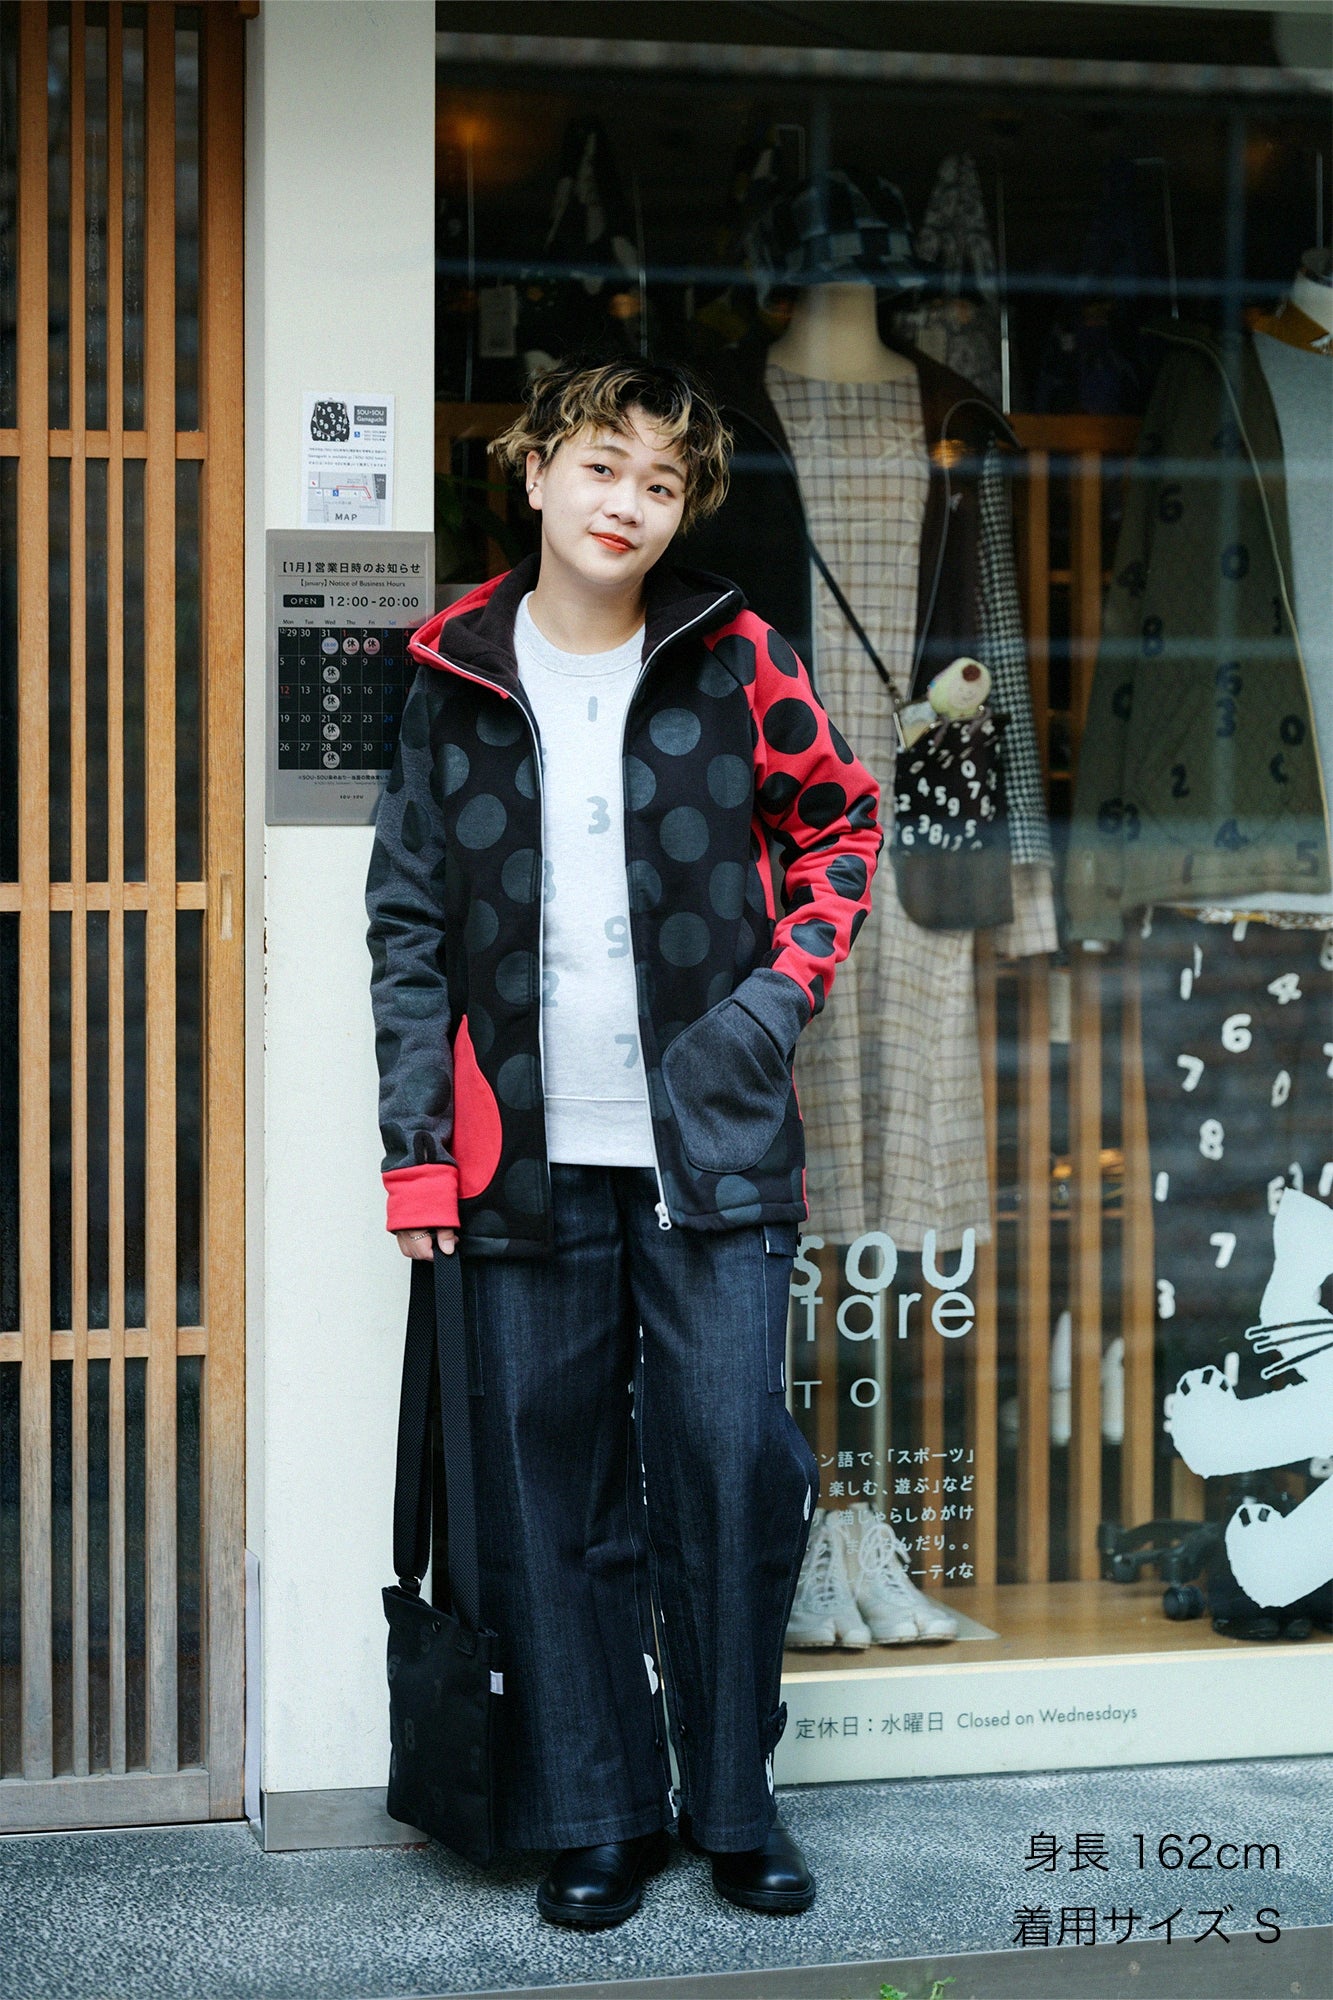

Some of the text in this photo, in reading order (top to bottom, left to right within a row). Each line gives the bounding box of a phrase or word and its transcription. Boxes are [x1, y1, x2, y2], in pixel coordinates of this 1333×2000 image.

[1159, 484, 1184, 525] 6
[334, 513, 358, 521] MAP
[387, 580, 406, 588] Hours
[290, 597, 317, 606] OPEN
[287, 629, 297, 638] 29
[300, 629, 311, 638] 30
[321, 629, 331, 638] 31
[362, 629, 368, 638] 2
[347, 639, 377, 648] 休 休
[1142, 613, 1165, 657] 8
[280, 657, 285, 666] 5
[300, 657, 306, 666] 6
[321, 657, 326, 666] 7
[341, 657, 348, 666] 8
[362, 657, 368, 666] 9
[384, 657, 394, 666] 10
[326, 667, 336, 676] 休
[280, 686, 290, 695] 12
[301, 686, 311, 695] 13
[321, 686, 331, 695] 14
[342, 686, 352, 695] 15
[363, 686, 373, 695] 16
[327, 695, 336, 705] 休
[280, 714, 290, 723] 19
[300, 714, 311, 723] 20
[321, 714, 331, 723] 21
[341, 714, 352, 723] 22
[362, 714, 373, 723] 23
[327, 724, 336, 733] 休
[1279, 713, 1306, 747] 0
[280, 743, 290, 752] 26
[300, 743, 311, 752] 27
[321, 743, 331, 752] 28
[342, 743, 352, 752] 29
[362, 743, 373, 752] 30
[327, 752, 336, 762] 休
[960, 759, 977, 779] 0
[967, 781, 982, 800] 7
[1170, 762, 1191, 799] 2
[899, 793, 912, 812] 2
[934, 785, 948, 806] 5
[586, 795, 611, 834] 3
[947, 797, 960, 817] 9
[917, 814, 931, 835] 3
[928, 823, 944, 846] 8
[964, 819, 978, 839] 5
[901, 825, 916, 846] 6
[604, 915, 631, 958] 9
[1267, 972, 1303, 1005] 4
[1220, 1013, 1253, 1054] 6
[614, 1033, 640, 1069] 7
[1176, 1054, 1205, 1092] 7
[1199, 1118, 1225, 1161] 8
[1209, 1231, 1237, 1269] 7
[813, 1447, 975, 1468] ン語で、「スポーツ」
[796, 1711, 944, 1740] 定休日：水曜日
[957, 1705, 1138, 1729] Closed on Wednesdays
